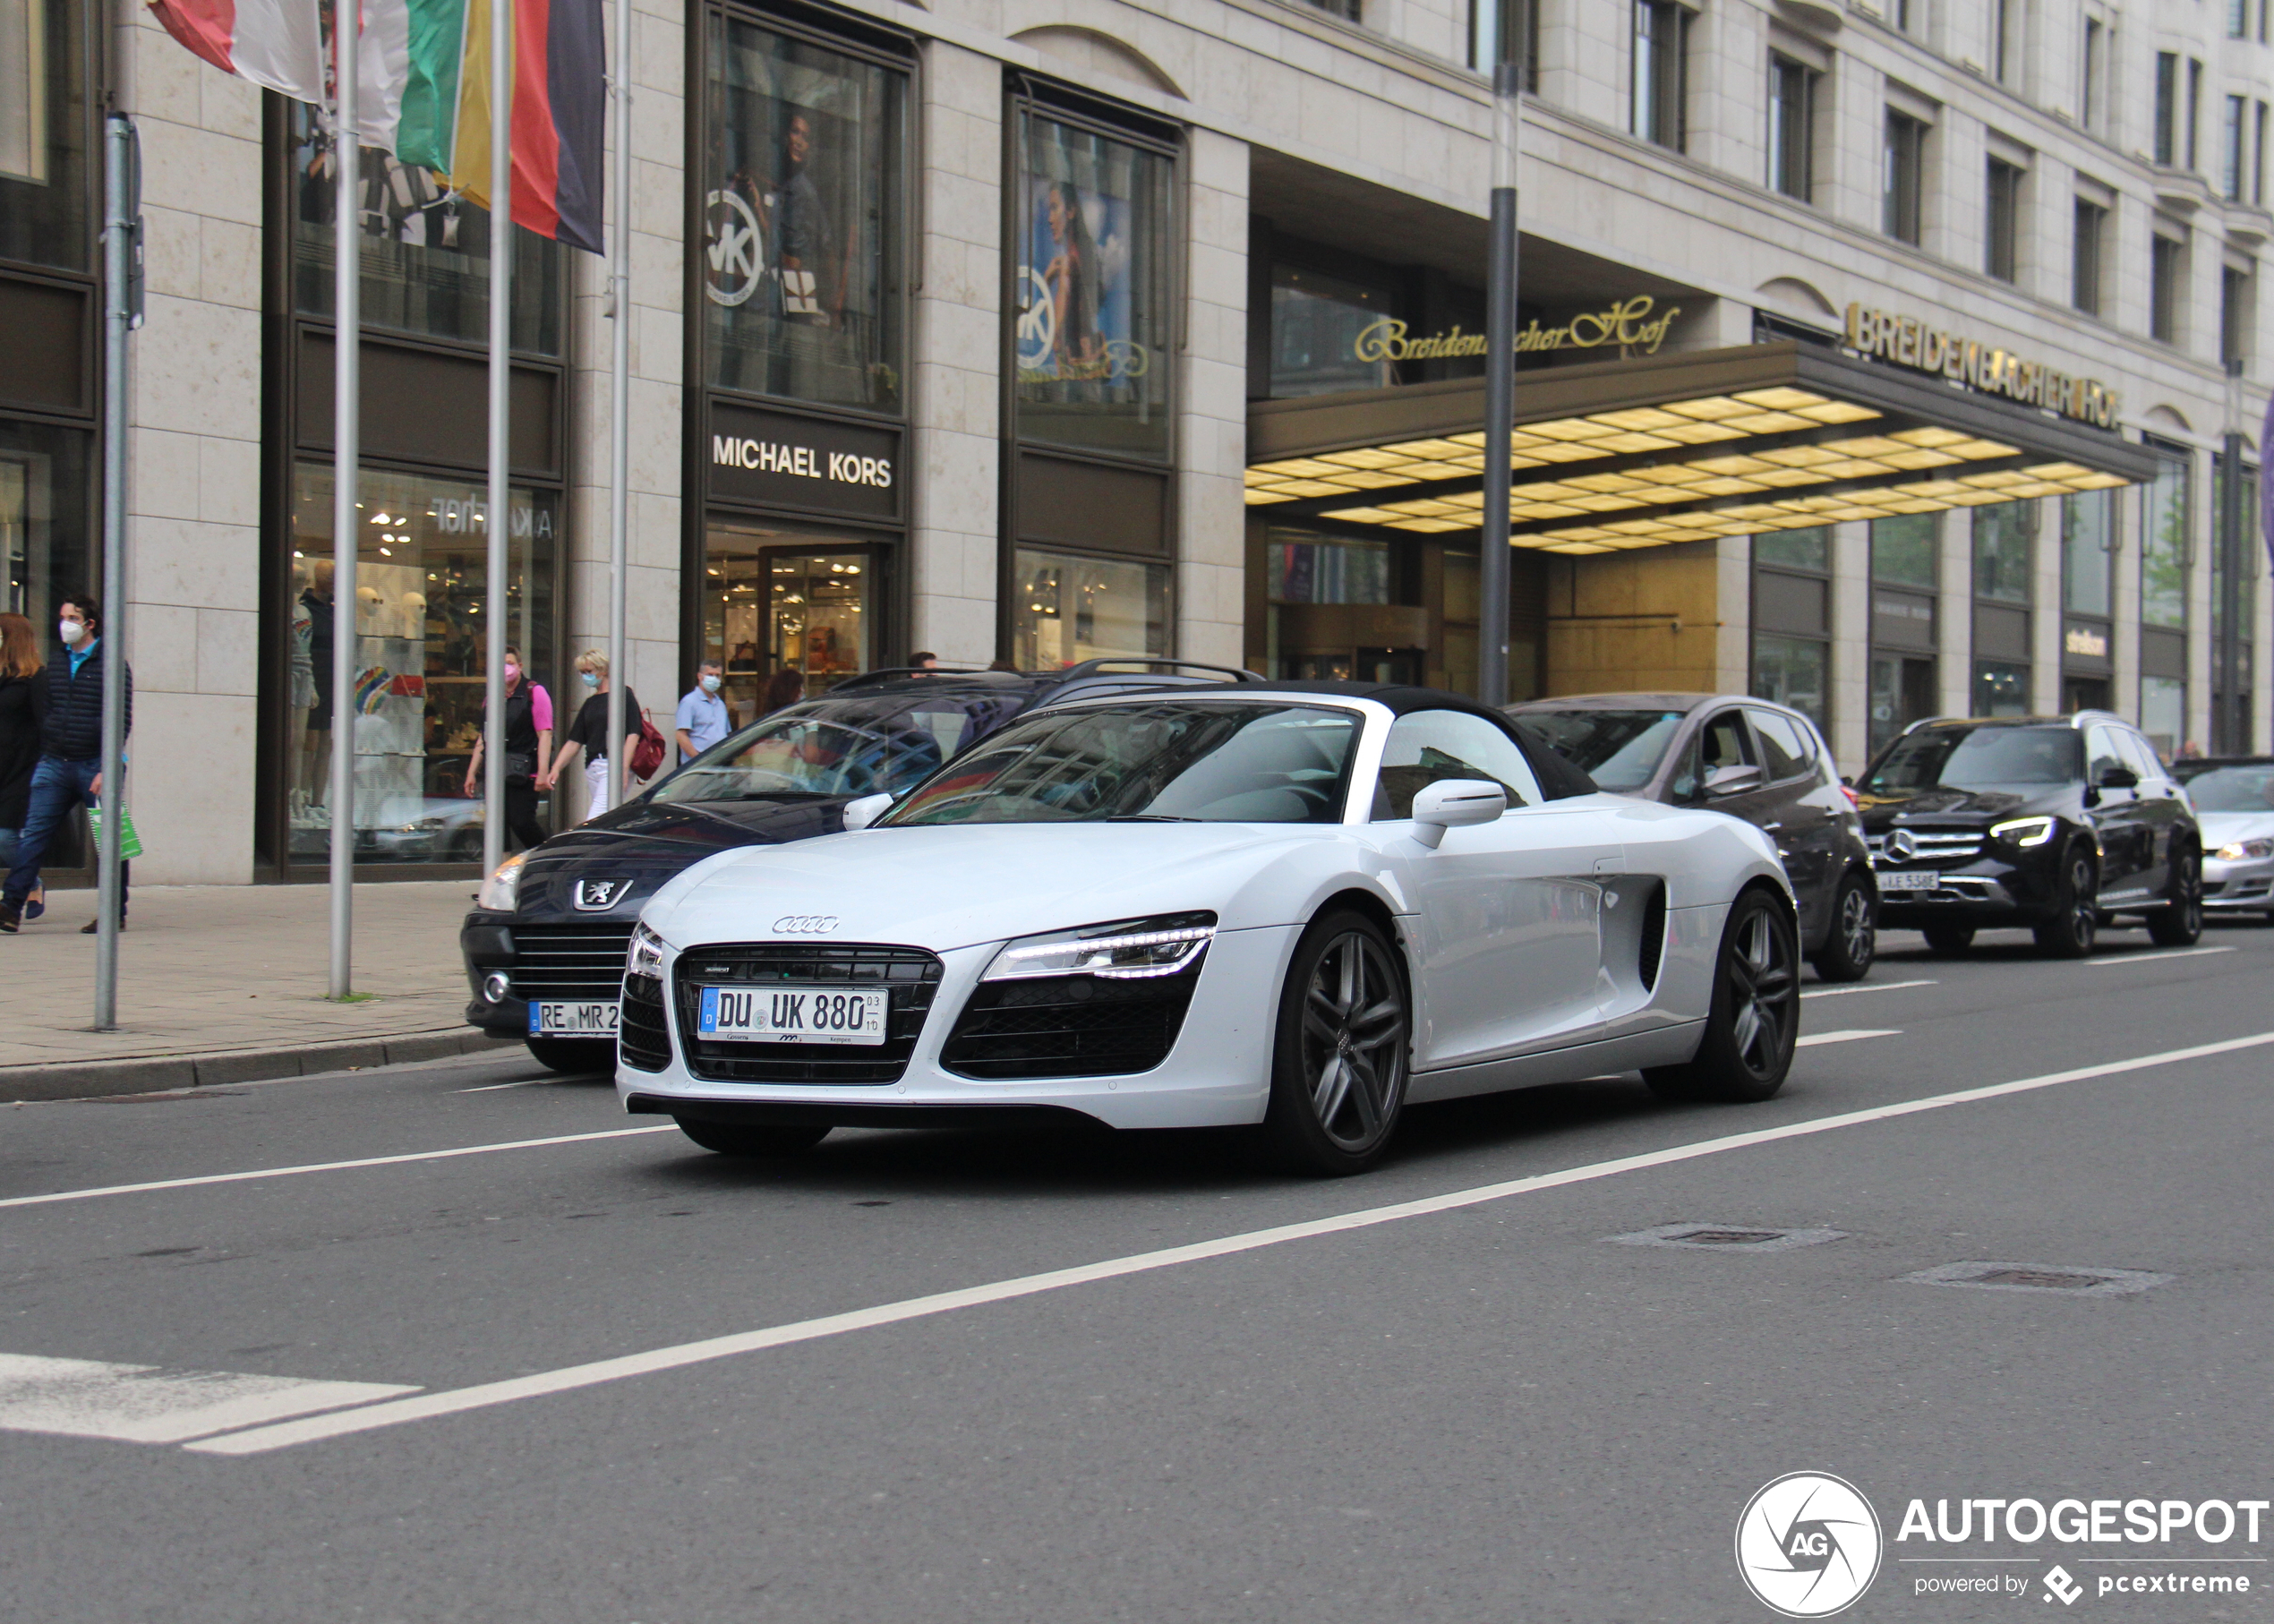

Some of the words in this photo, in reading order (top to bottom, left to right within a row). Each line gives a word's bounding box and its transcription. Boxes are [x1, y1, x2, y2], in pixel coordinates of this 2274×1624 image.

[1355, 318, 1568, 363] Breidencher
[1569, 303, 1680, 355] Hof
[1846, 303, 2075, 417] BREIDENBACHER
[713, 434, 822, 479] MICHAEL
[829, 451, 892, 488] KORS
[542, 1005, 566, 1028] RE
[578, 1005, 603, 1028] MR
[609, 1005, 619, 1028] 2
[719, 993, 752, 1028] DU
[771, 994, 806, 1029] UK
[813, 995, 864, 1030] 880
[867, 996, 880, 1006] 03
[867, 1020, 878, 1030] 10
